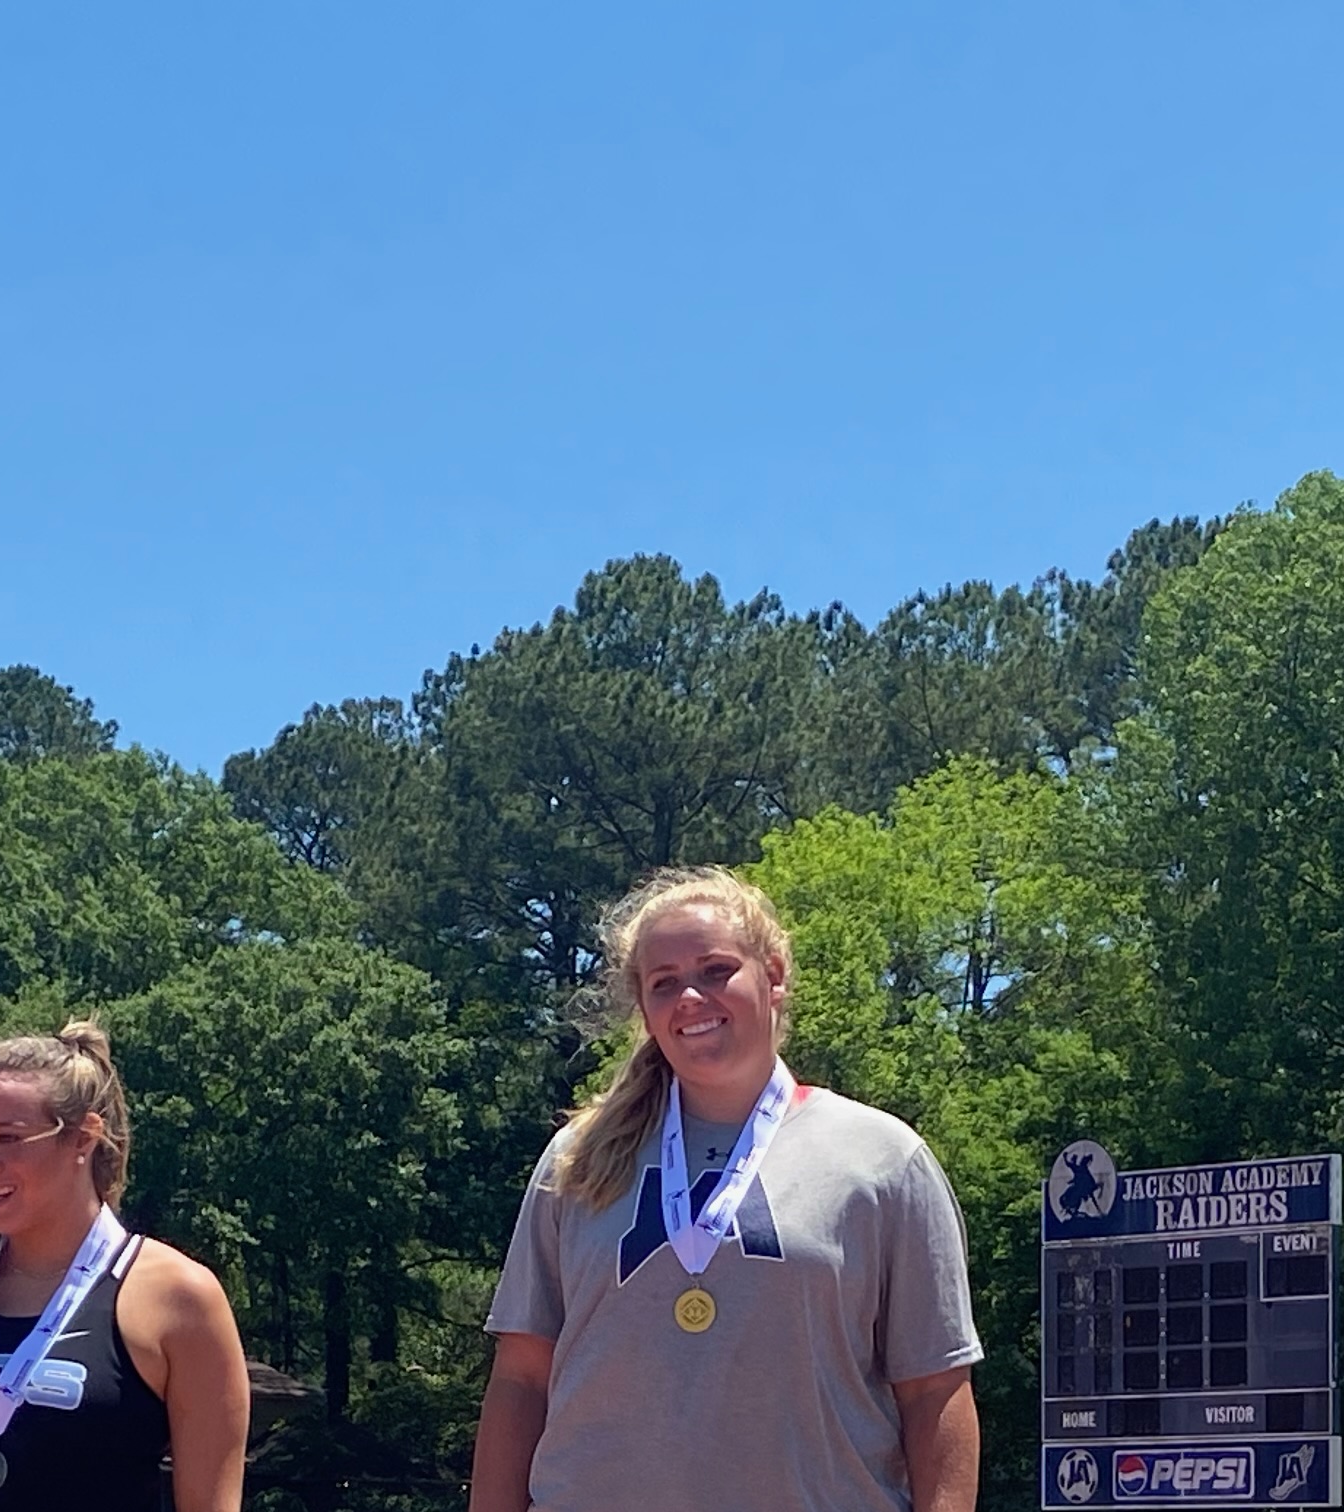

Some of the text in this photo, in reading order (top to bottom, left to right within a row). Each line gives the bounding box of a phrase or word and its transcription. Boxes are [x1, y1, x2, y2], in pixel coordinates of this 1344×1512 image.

[1122, 1161, 1325, 1201] JACKSON ACADEMY
[1155, 1190, 1289, 1231] RAIDERS
[1167, 1241, 1201, 1260] TIME
[1273, 1233, 1318, 1252] EVENT
[1062, 1410, 1097, 1428] HOME
[1205, 1405, 1255, 1424] VISITOR
[1150, 1457, 1247, 1491] PEPSI
